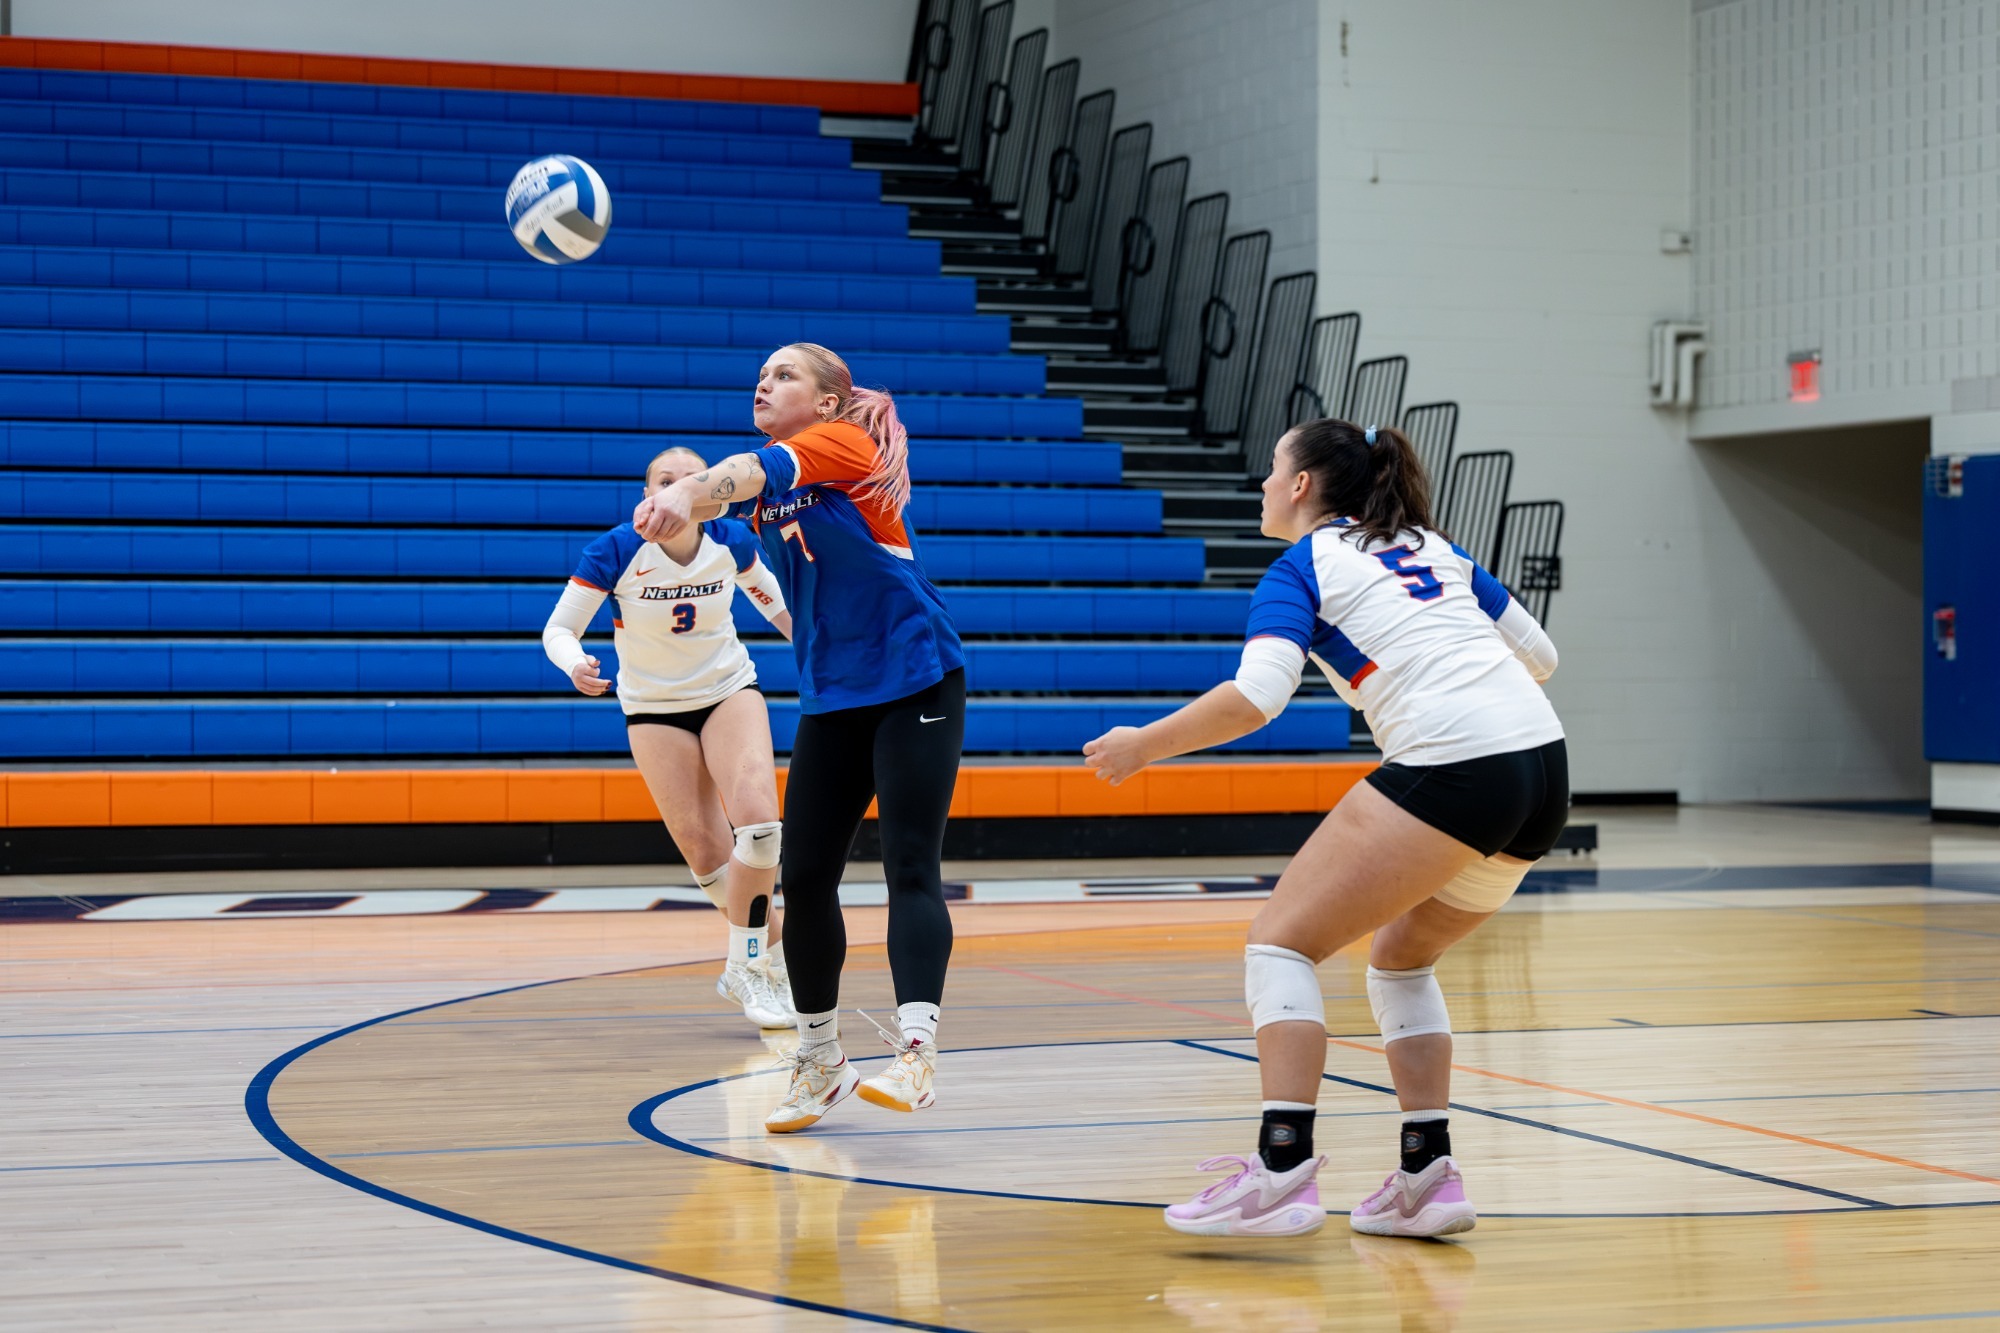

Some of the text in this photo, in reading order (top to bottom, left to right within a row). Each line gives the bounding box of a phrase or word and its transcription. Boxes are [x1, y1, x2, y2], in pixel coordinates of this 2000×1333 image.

[761, 493, 819, 522] NE PALT
[779, 519, 816, 563] 7
[1370, 543, 1445, 602] 5
[642, 581, 724, 600] NEW PALTZ
[671, 603, 696, 634] 3
